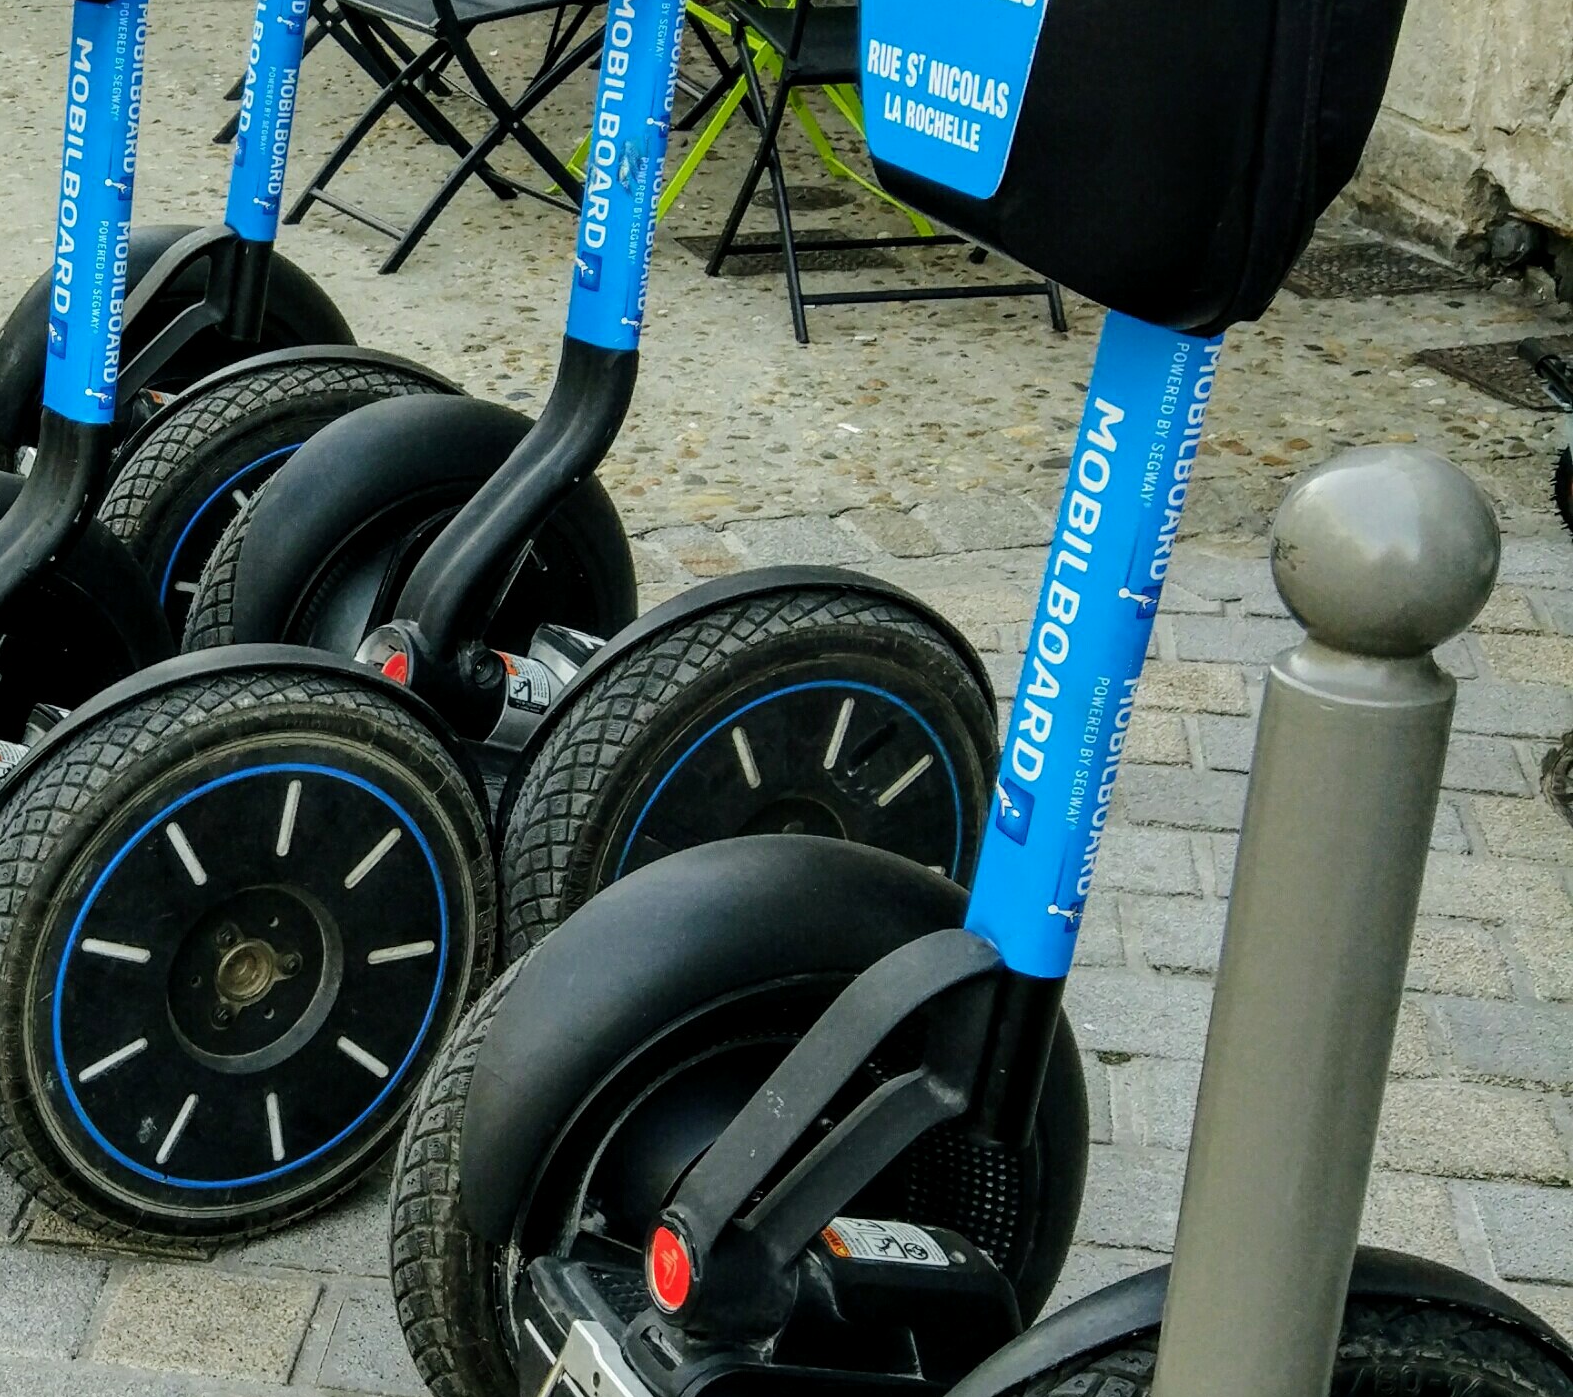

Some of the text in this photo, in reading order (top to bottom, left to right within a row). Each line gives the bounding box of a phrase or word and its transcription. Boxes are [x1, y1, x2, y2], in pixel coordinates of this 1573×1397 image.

[115, 2, 129, 54] POWERED
[114, 57, 123, 70] BY
[122, 2, 149, 176] MOBILBOARD
[867, 39, 903, 83] RUE
[928, 60, 1010, 119] NICOLAS
[267, 68, 297, 196] MOBILBOARD
[884, 92, 981, 153] LA ROCHELLE
[54, 38, 93, 314] MOBILBOARD
[95, 270, 104, 281] BY
[97, 220, 109, 268] POWERED
[103, 221, 131, 384] MOBILBOARD
[1162, 342, 1189, 415] POWERED
[1150, 344, 1222, 581] MOBILBOARD
[1156, 419, 1171, 438] BY
[1012, 397, 1125, 782] MOBILBOARD
[1084, 676, 1110, 744] POWERED
[1078, 747, 1094, 766] BY
